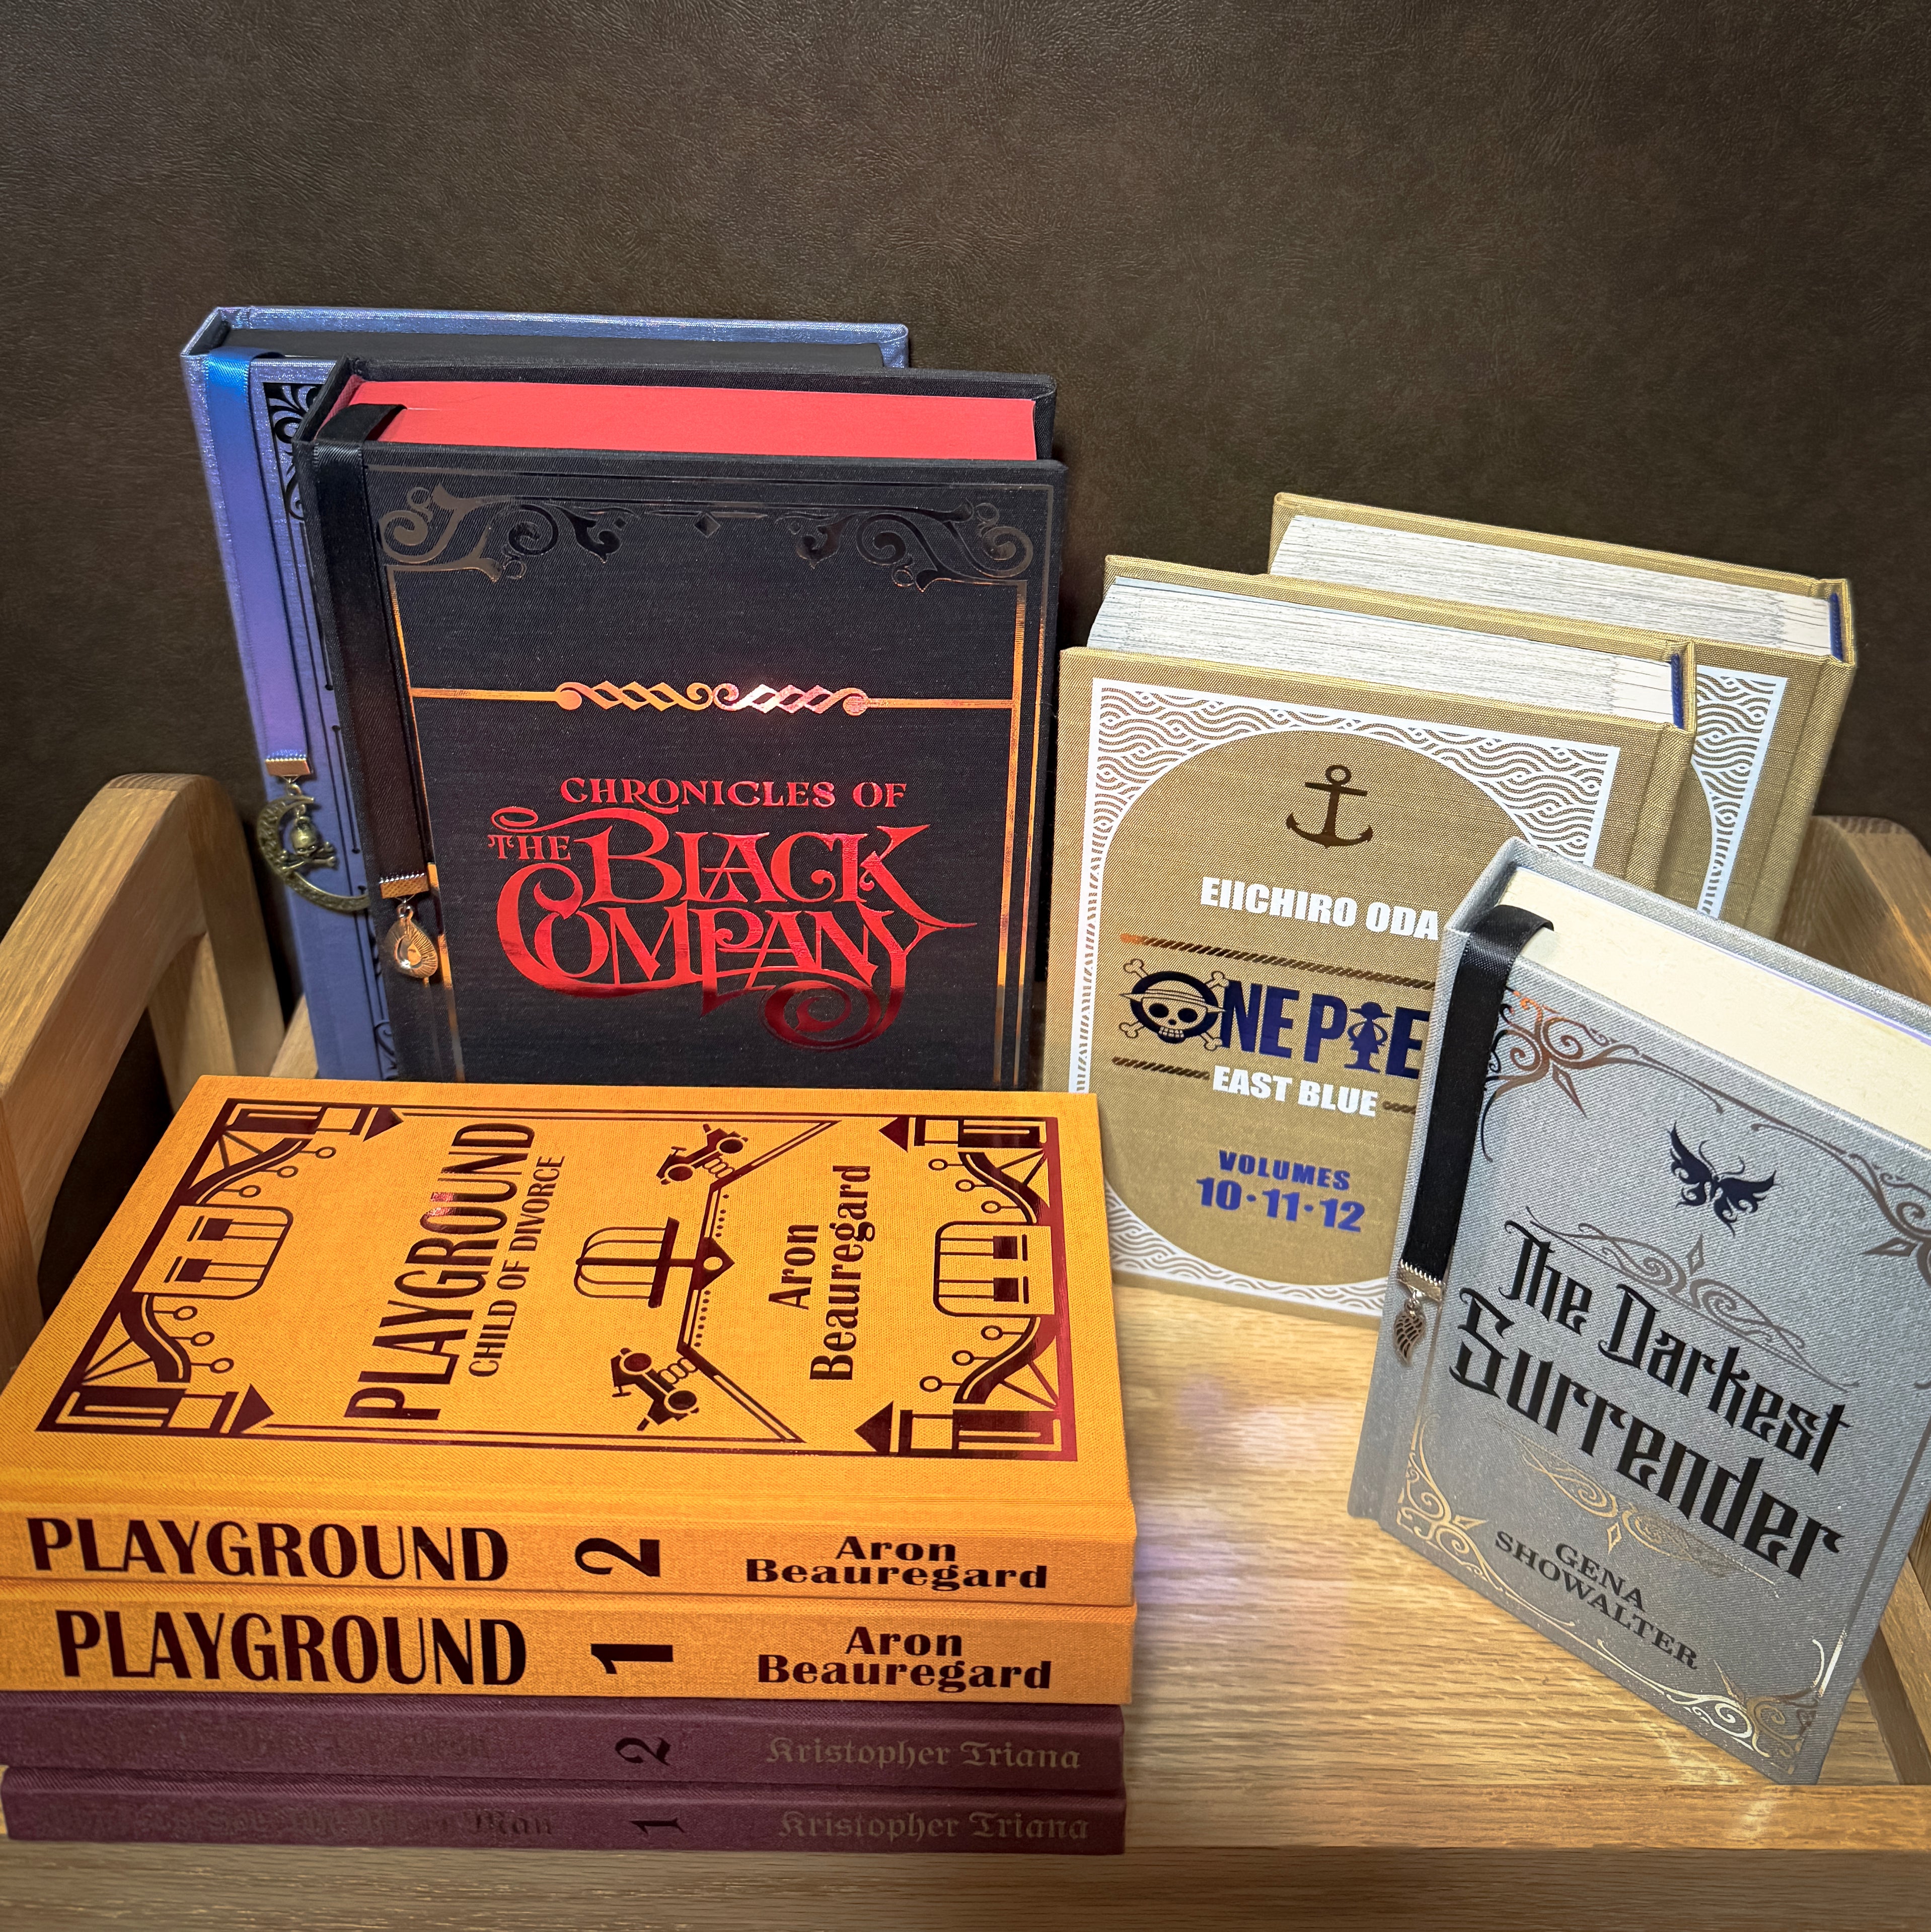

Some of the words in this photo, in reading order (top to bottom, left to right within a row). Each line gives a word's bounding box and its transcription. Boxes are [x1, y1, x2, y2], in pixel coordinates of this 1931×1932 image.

[560, 777, 835, 814] CHRONICLES
[853, 781, 907, 809] OF
[487, 834, 572, 861] THE
[492, 807, 978, 929] BLACK
[1200, 877, 1358, 927] EIICHIRO
[1366, 901, 1439, 941] ODA
[497, 862, 946, 1051] COMPANY
[1212, 1065, 1293, 1102] EAST
[1298, 1081, 1379, 1117] BLUE
[1219, 1150, 1350, 1191] VOLUMES
[508, 1156, 565, 1252] DIVORCE
[344, 1123, 535, 1420] PLAYGROUND
[496, 1259, 530, 1291] OF
[768, 1223, 819, 1310] Aron
[809, 1165, 876, 1381] Beauregard
[468, 1299, 517, 1378] CHILD
[1498, 1220, 1593, 1336] The
[1597, 1283, 1853, 1475] Darkest
[1449, 1286, 1846, 1580] Surrender
[27, 1517, 508, 1582] PLAYGROUND
[574, 1537, 661, 1578] 2
[746, 1558, 1048, 1591] Beauregard
[835, 1535, 956, 1562] Aron
[1494, 1530, 1697, 1671] SHOWALTER
[1554, 1542, 1645, 1612] GENA
[55, 1609, 527, 1685] PLAYGROUND
[590, 1643, 674, 1674] 1
[844, 1626, 962, 1657] Aron
[757, 1653, 1052, 1693] Beauregard
[615, 1737, 672, 1766] 2
[766, 1736, 951, 1770] Kristopher
[960, 1740, 1081, 1769] Triana
[629, 1817, 686, 1834] 1
[778, 1811, 959, 1843] Kristopher
[969, 1812, 1089, 1840] Triana
